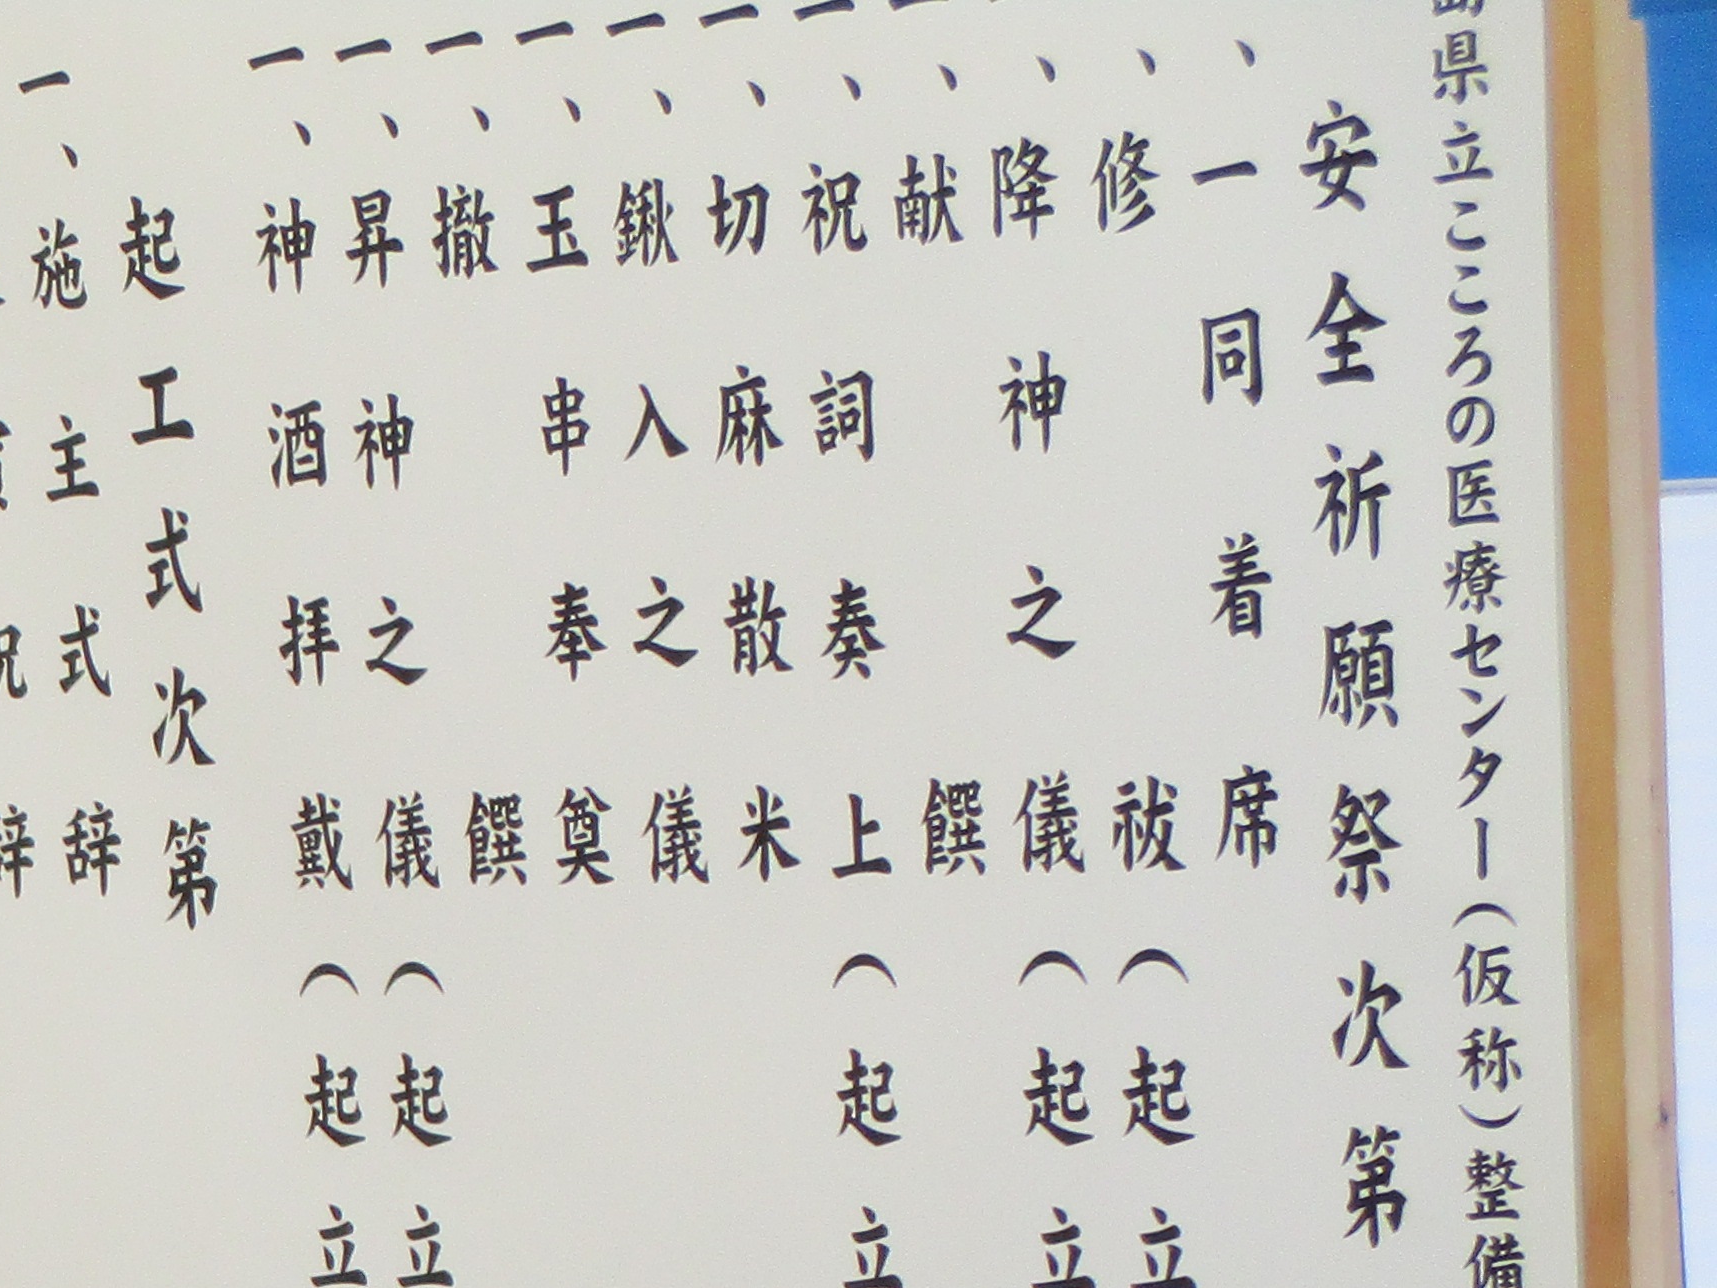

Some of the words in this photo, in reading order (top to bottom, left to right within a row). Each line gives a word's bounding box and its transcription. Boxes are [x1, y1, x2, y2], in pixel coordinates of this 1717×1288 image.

[119, 196, 218, 930] 起工式次第
[1300, 100, 1409, 1248] 安全祈願祭次第
